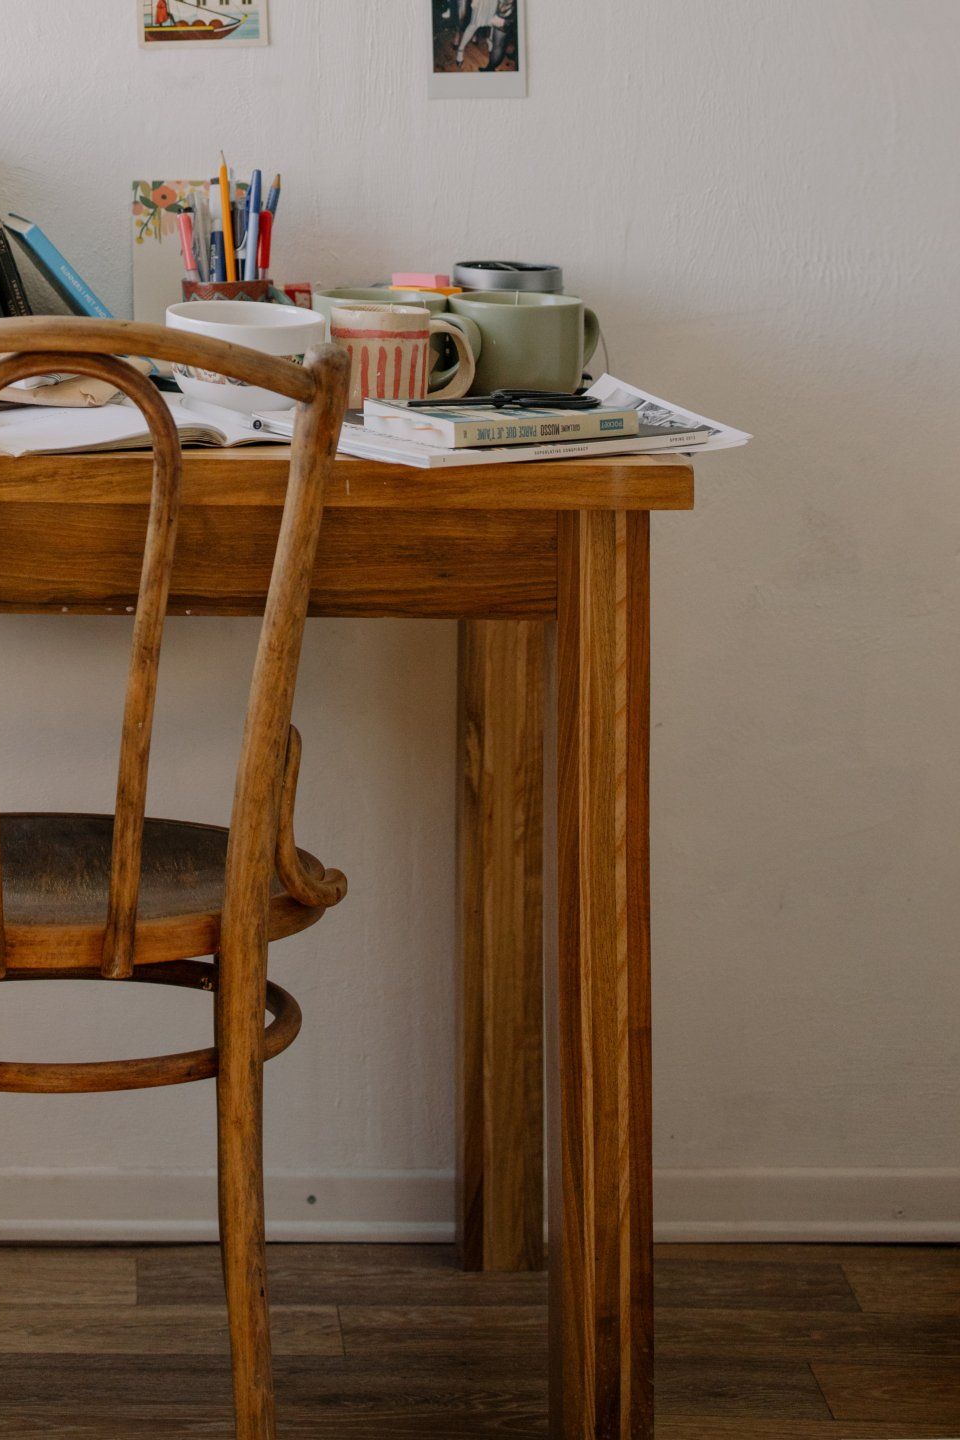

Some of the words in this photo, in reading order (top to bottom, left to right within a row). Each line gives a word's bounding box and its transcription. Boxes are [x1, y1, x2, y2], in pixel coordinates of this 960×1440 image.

[60, 265, 83, 292] RUNNERS
[518, 424, 537, 438] PARCE
[540, 423, 560, 437] MUSSO
[560, 423, 580, 433] GUILLAUME
[600, 419, 623, 430] POCKET
[476, 428, 495, 441] T'AIME
[496, 427, 504, 439] JE
[506, 426, 517, 439] QUE
